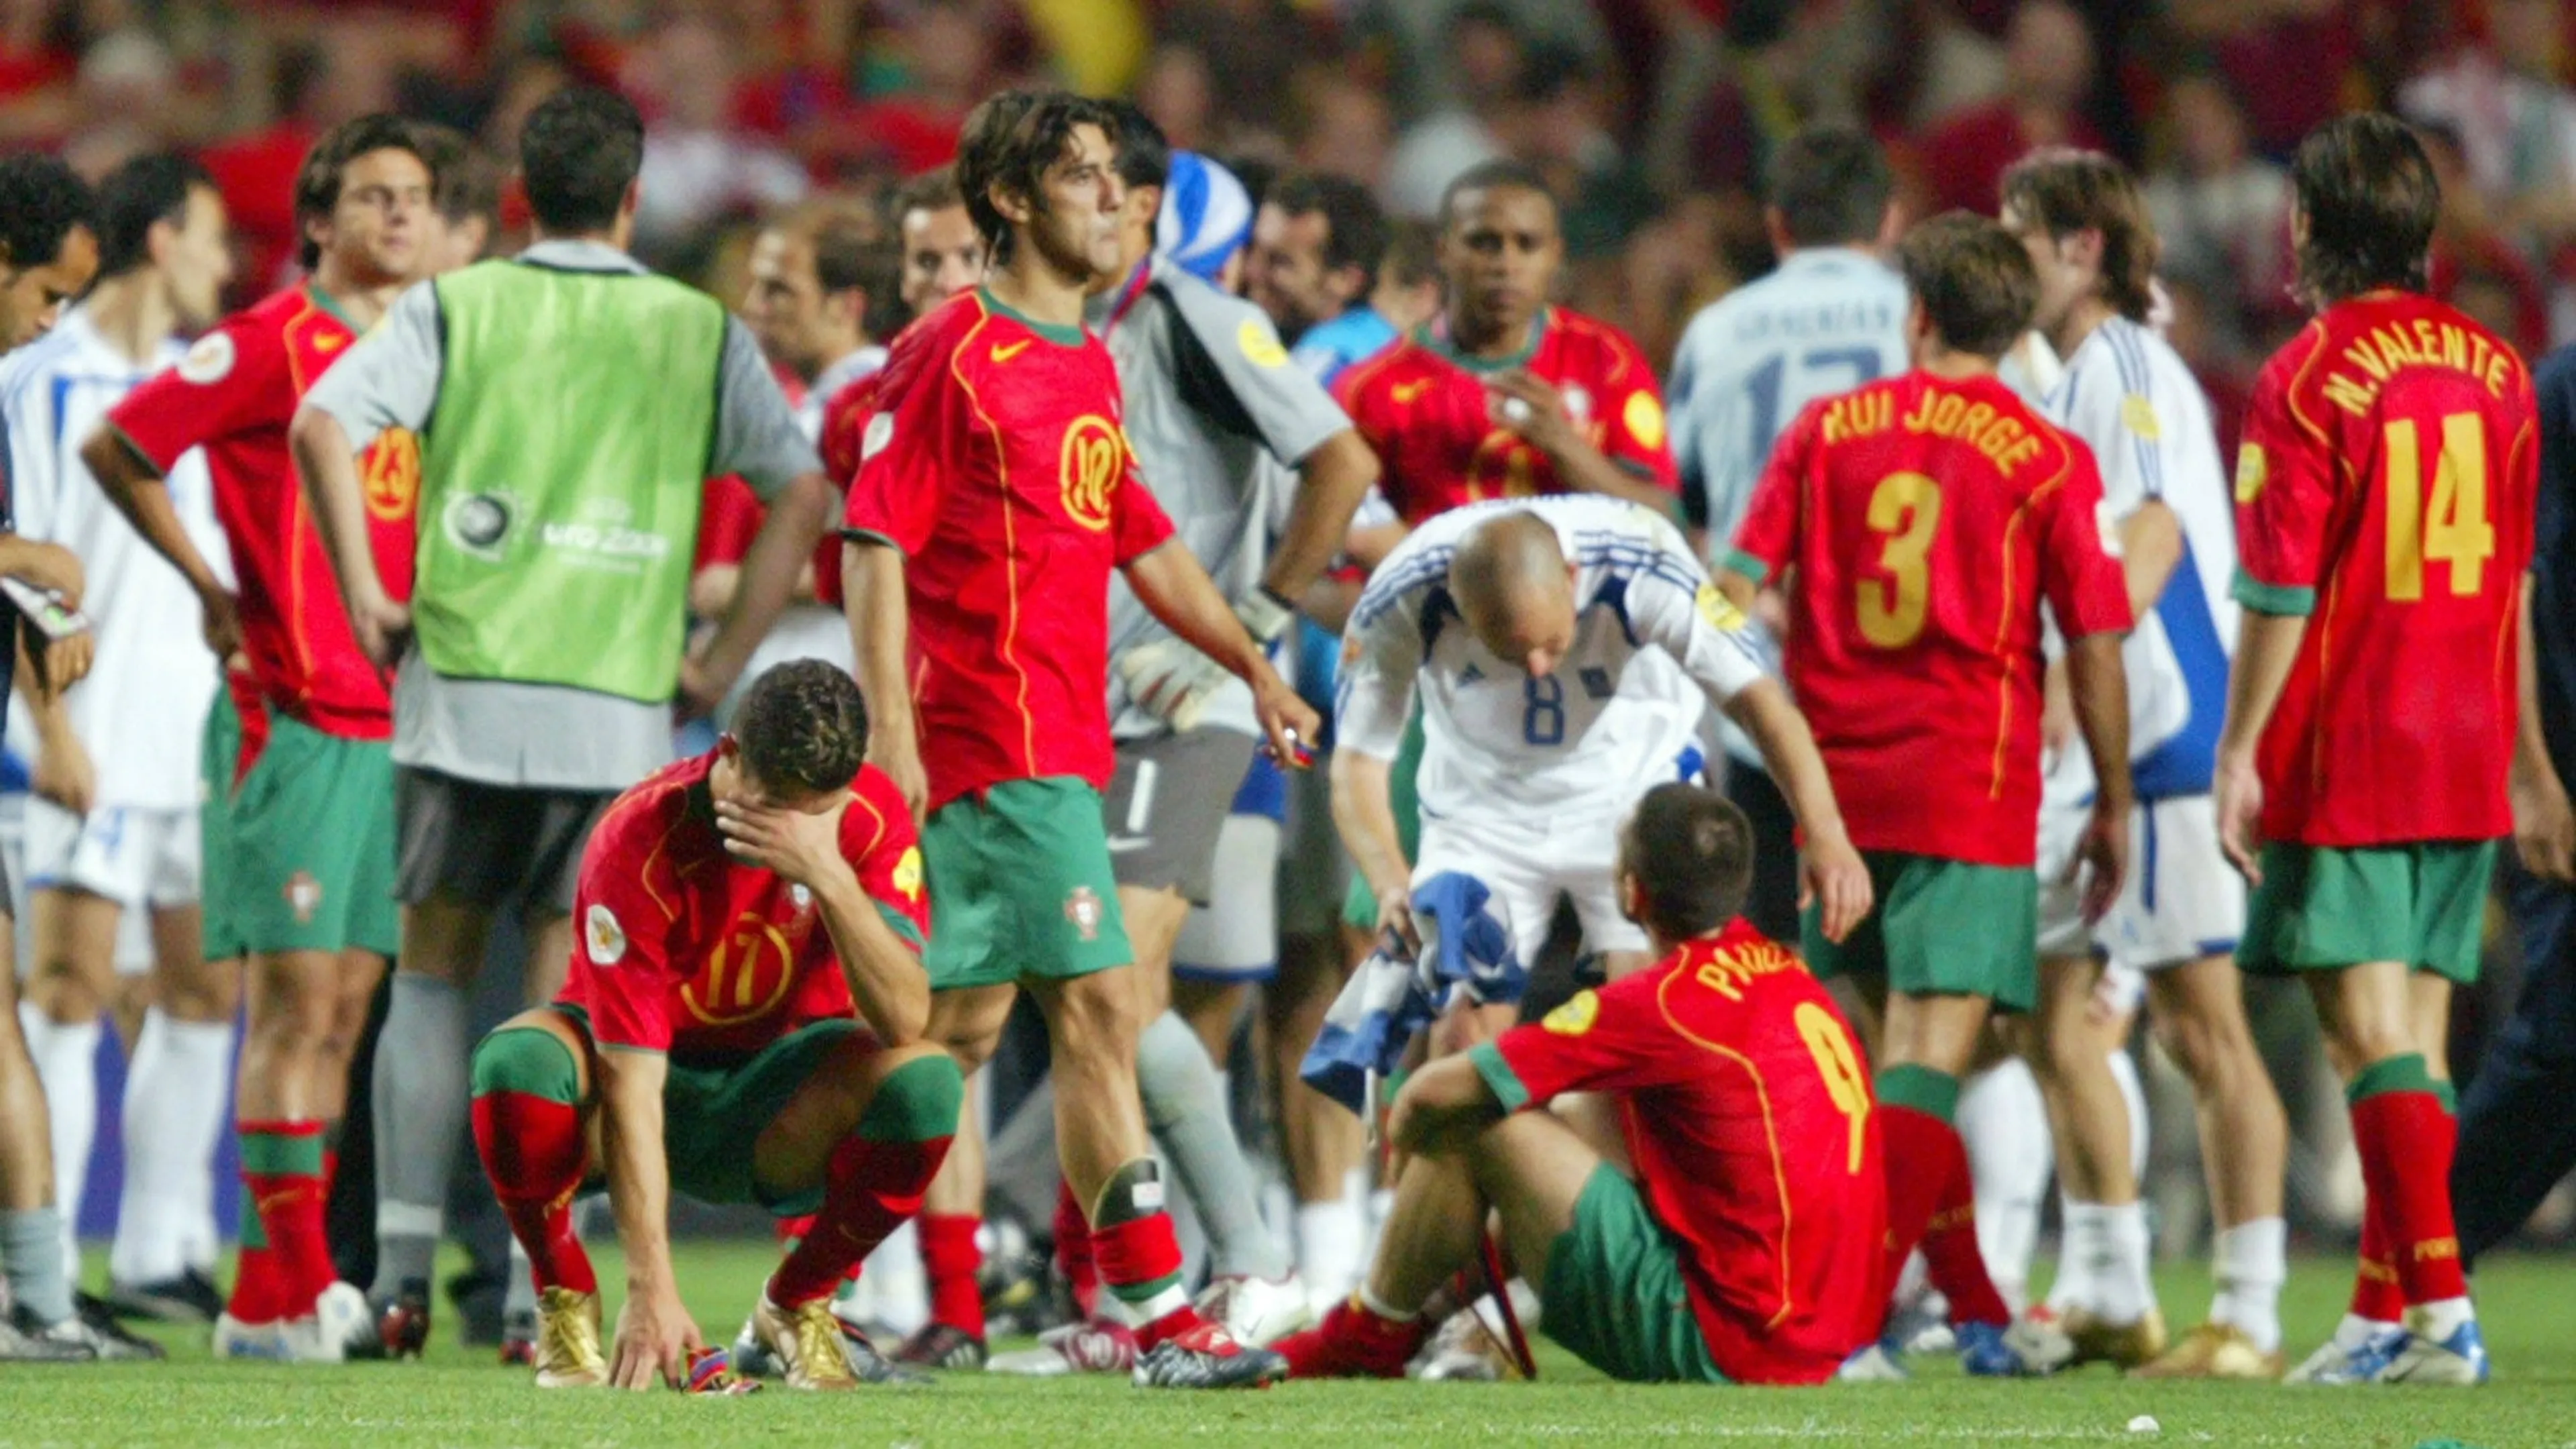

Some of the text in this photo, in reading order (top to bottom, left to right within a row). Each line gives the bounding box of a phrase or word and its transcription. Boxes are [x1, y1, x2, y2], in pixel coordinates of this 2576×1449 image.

[2322, 318, 2510, 418] N.VALENTE
[368, 429, 411, 498] 23
[1903, 386, 2041, 478] JORGE
[1074, 437, 1112, 514] 10
[2383, 411, 2496, 602] 14
[1856, 471, 1941, 647] 3
[1525, 673, 1564, 745] 8
[1128, 758, 1157, 833] 1
[708, 934, 760, 1008] 17
[1793, 1001, 1871, 1175] 9
